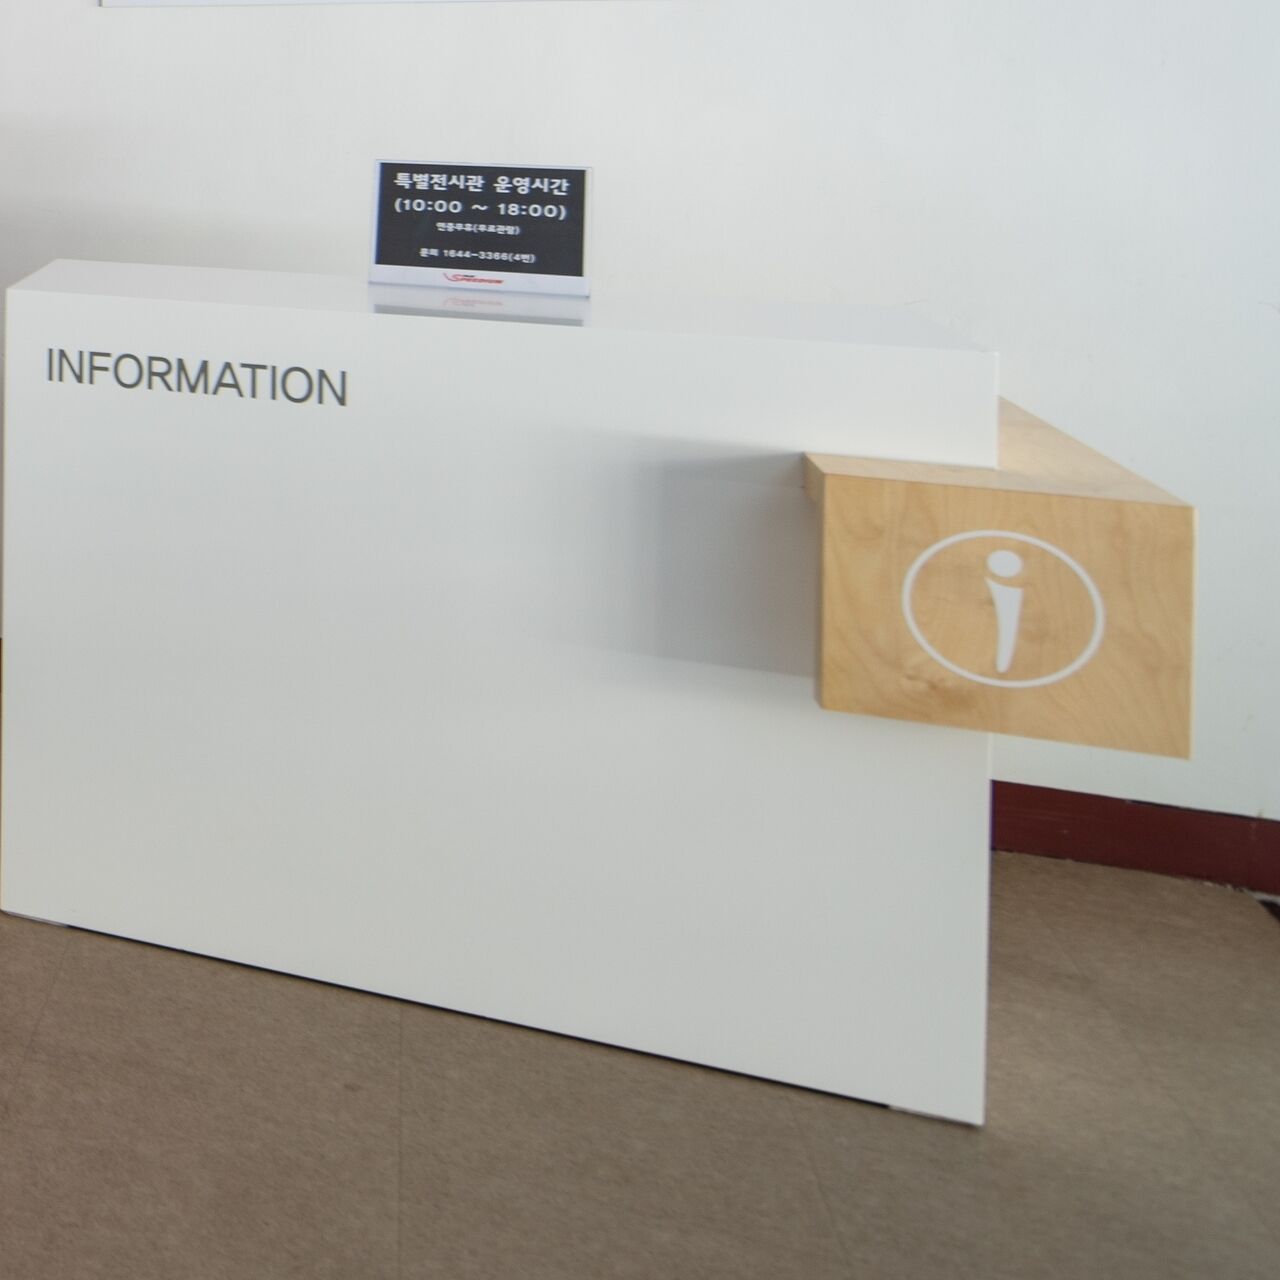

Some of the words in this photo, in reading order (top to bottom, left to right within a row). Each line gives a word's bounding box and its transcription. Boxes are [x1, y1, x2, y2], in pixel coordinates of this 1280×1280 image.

[393, 172, 485, 192] 특별전시관
[493, 176, 570, 196] 운영시간
[394, 198, 463, 213] (10:00
[497, 203, 567, 220] 18:00)
[47, 347, 347, 407] INFORMATION
